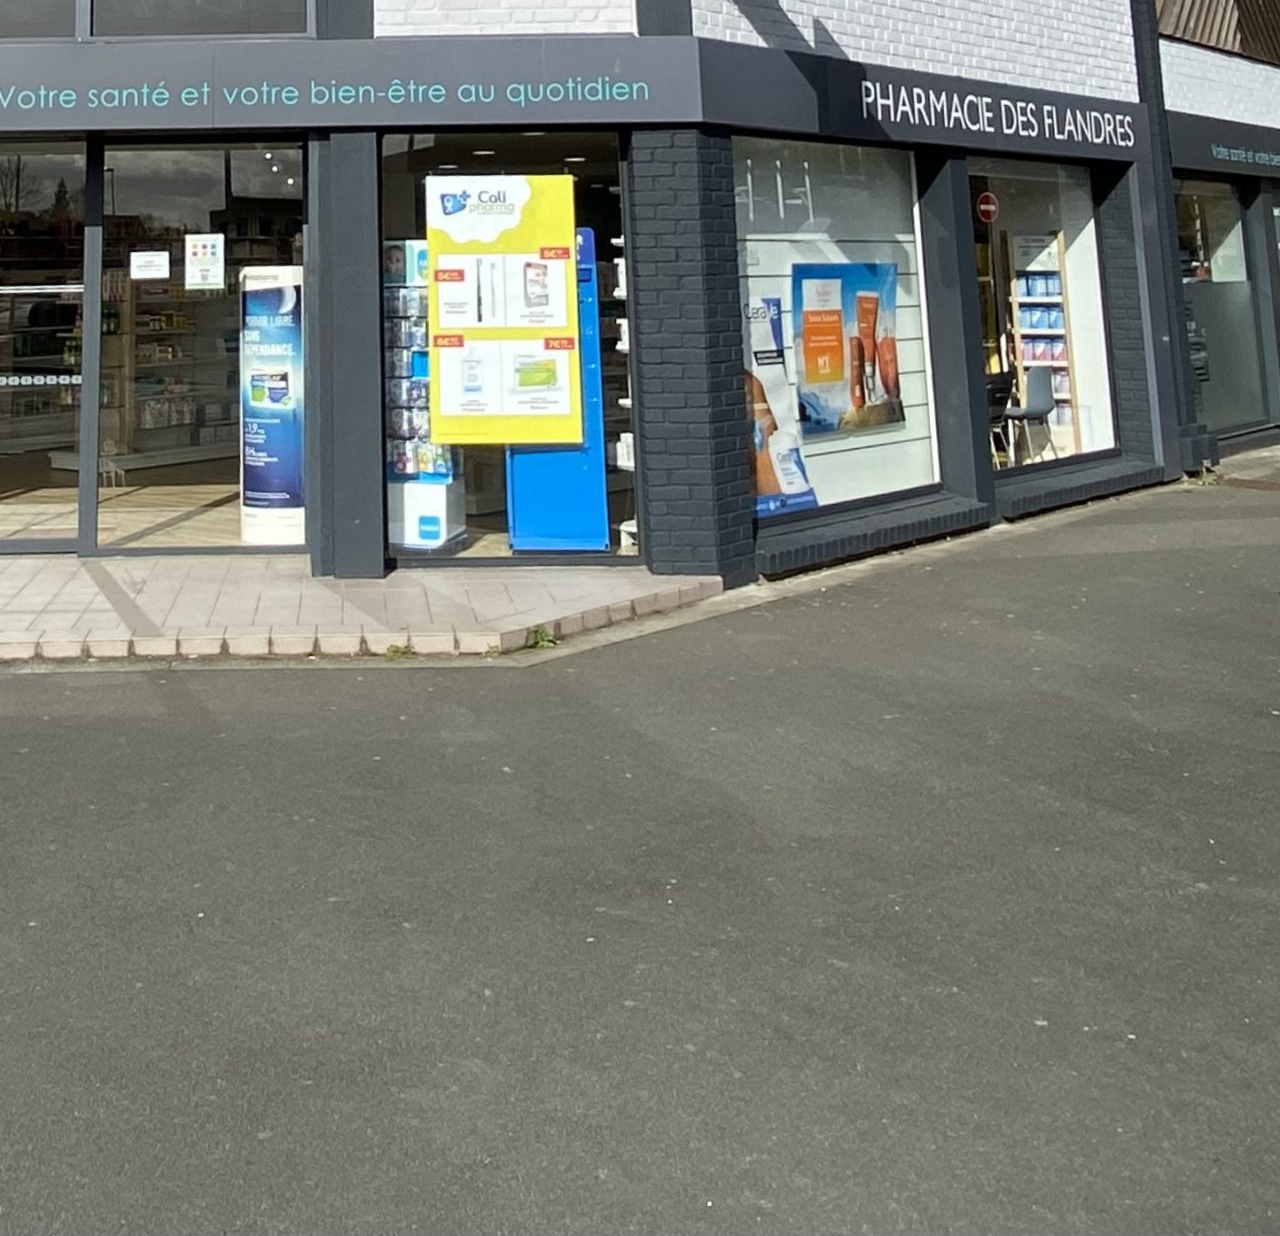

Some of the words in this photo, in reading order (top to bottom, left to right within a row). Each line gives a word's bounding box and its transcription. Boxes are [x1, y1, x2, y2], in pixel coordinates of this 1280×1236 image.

[87, 79, 170, 108] santé
[180, 81, 211, 106] et
[223, 80, 300, 106] votre
[310, 78, 446, 105] bien-être
[458, 83, 497, 104] au
[506, 76, 650, 109] quotidien
[862, 80, 995, 133] PHARMACIE
[1001, 99, 1039, 138] DES
[1044, 104, 1136, 148] FLANDRES
[469, 203, 515, 214] pharma
[477, 190, 507, 204] Cali
